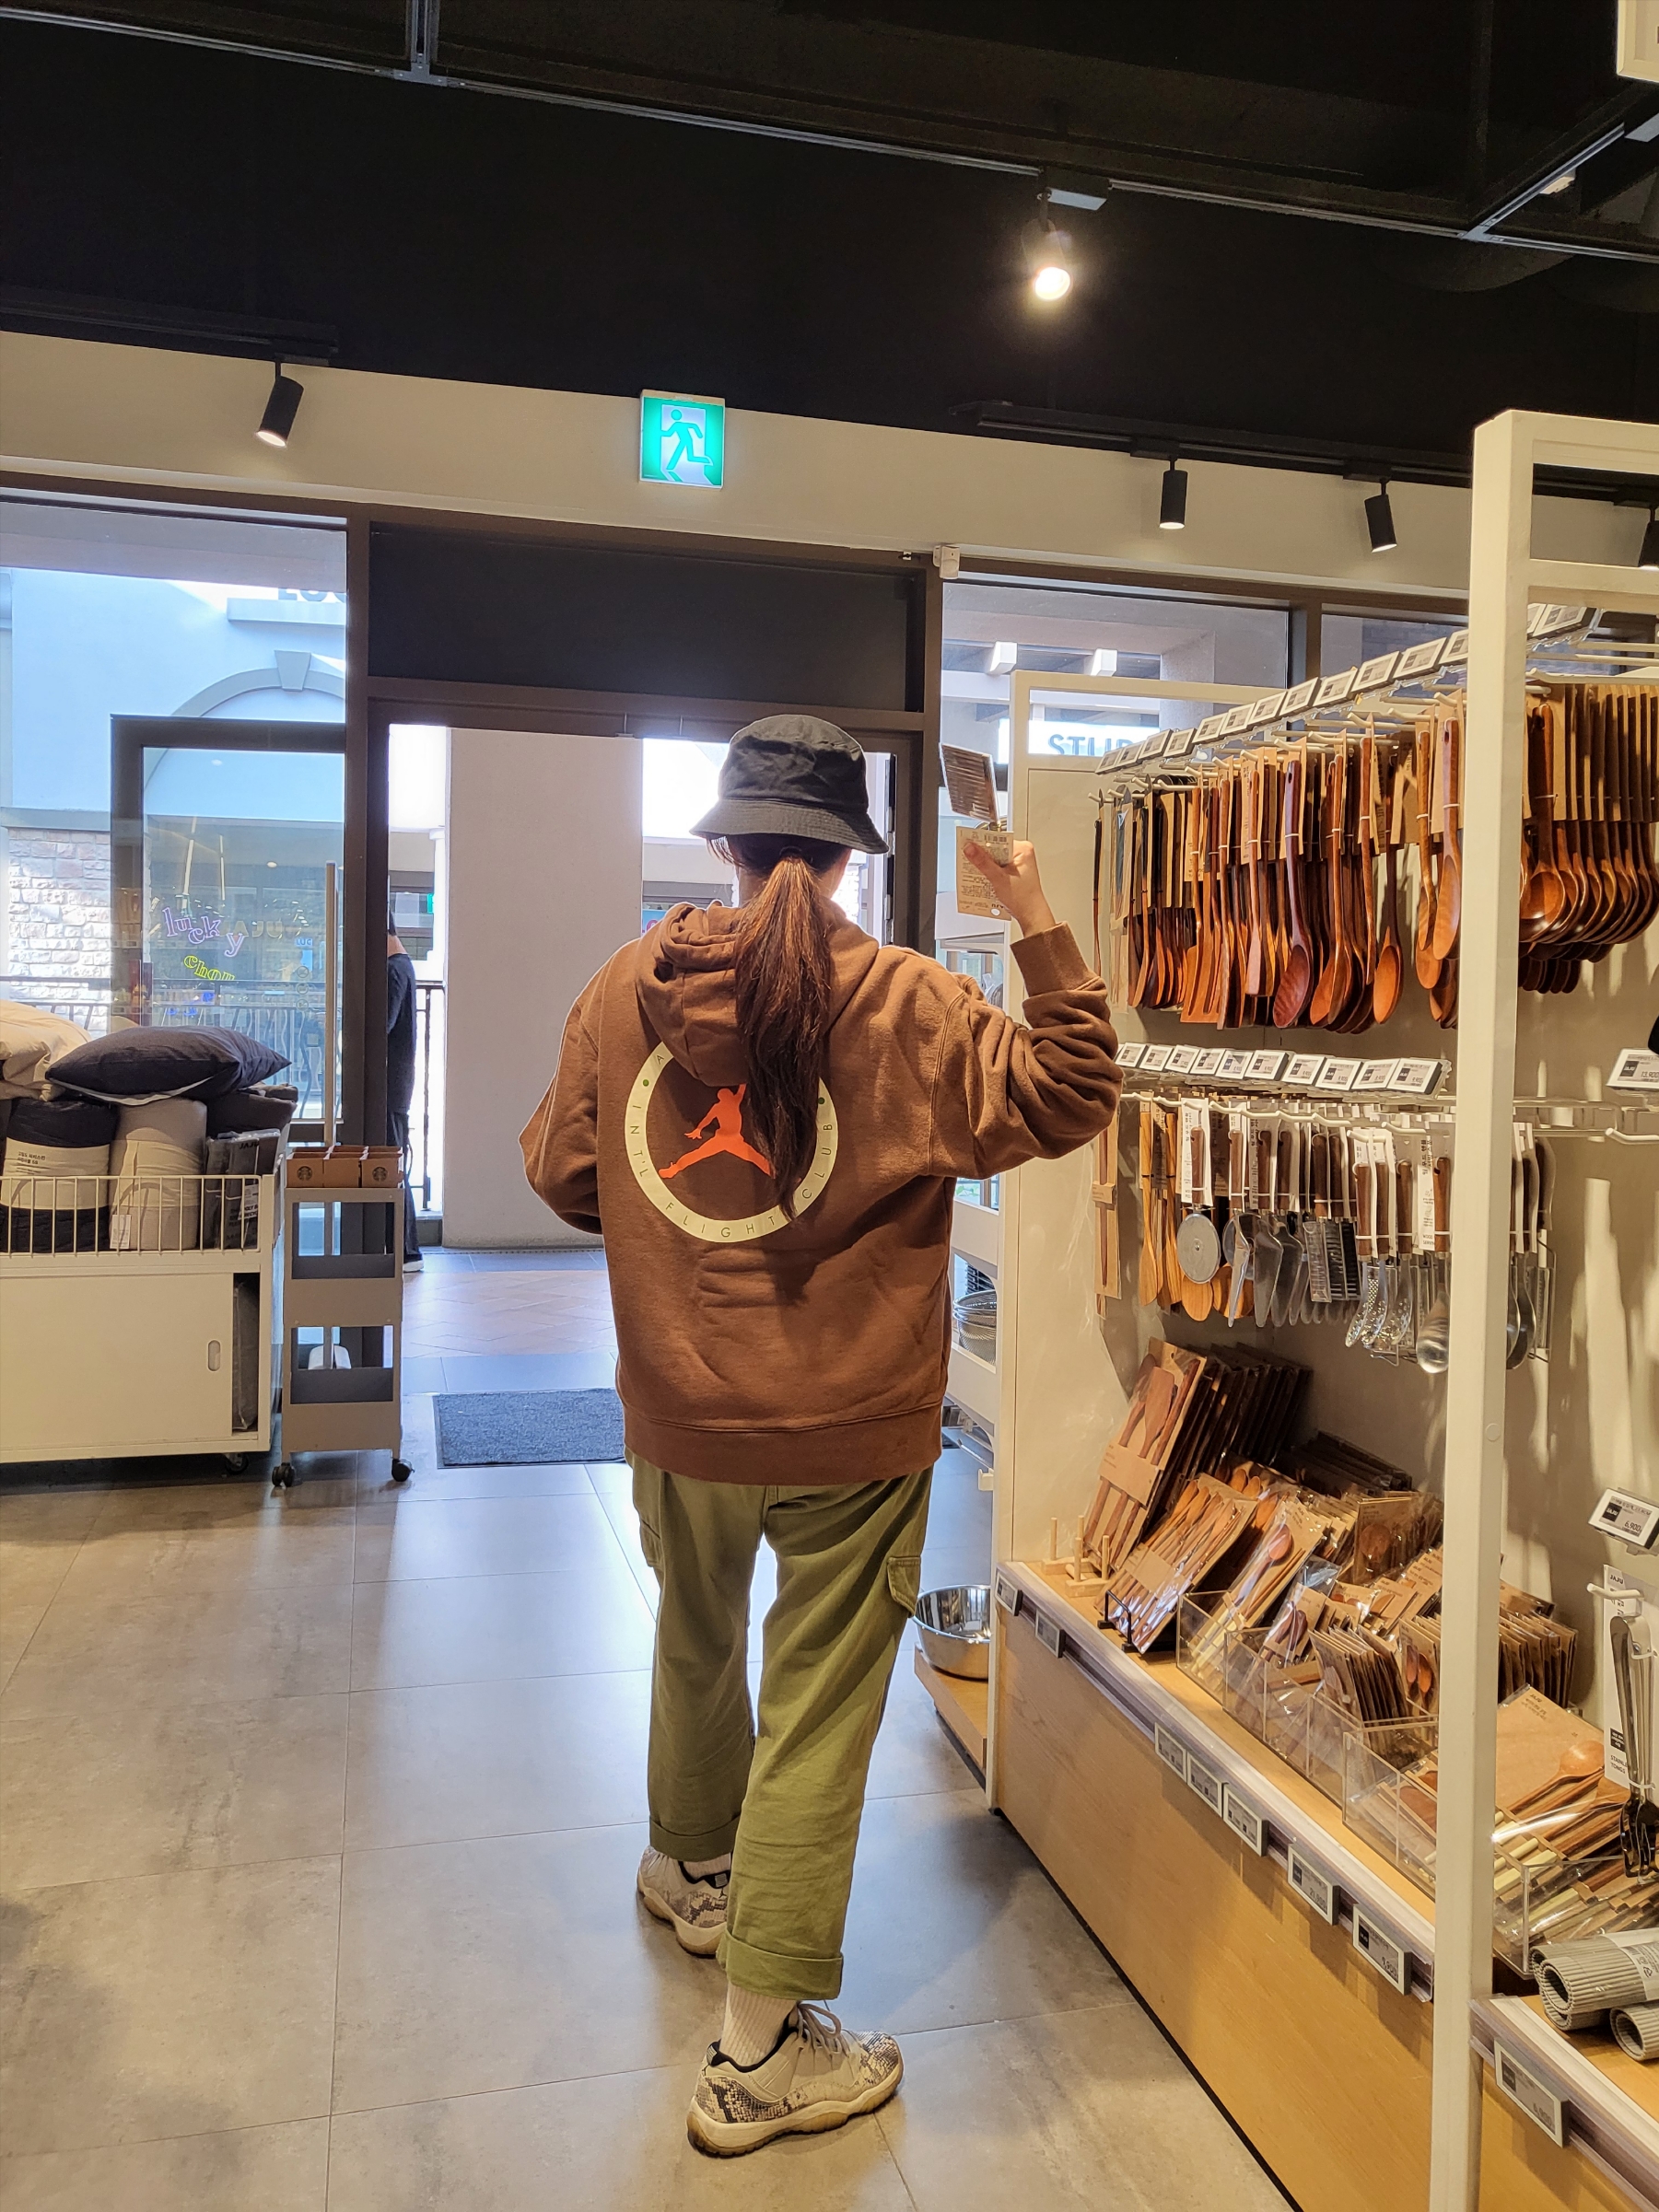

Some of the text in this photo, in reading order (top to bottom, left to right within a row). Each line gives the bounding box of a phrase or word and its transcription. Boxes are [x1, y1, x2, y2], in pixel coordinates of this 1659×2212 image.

[162, 907, 245, 958] lucky
[666, 1202, 777, 1238] FLIGHT
[801, 1123, 833, 1200] CLUB
[1624, 1520, 1641, 1532] 6,900
[1610, 1574, 1624, 1584] JAJU
[1610, 1754, 1628, 1767] STAINLE
